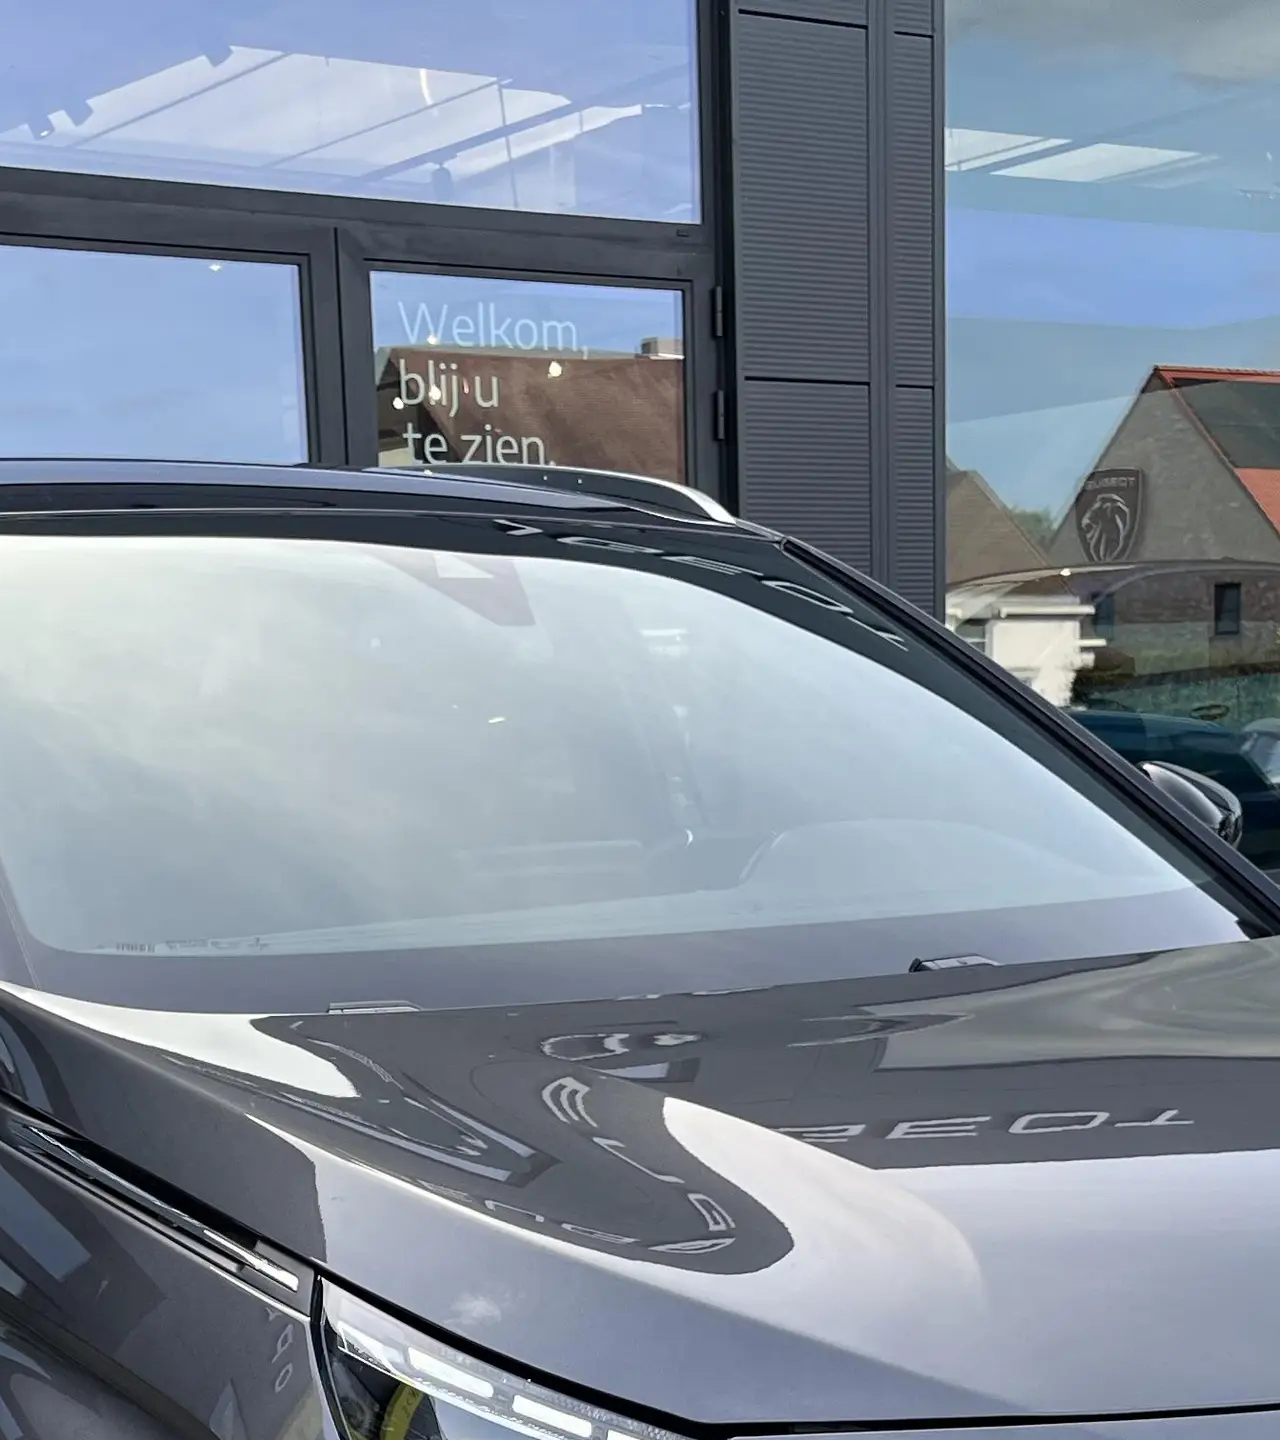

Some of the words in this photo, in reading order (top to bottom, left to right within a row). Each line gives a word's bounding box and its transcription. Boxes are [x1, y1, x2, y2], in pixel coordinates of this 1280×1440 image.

[398, 302, 589, 359] Welkom,
[400, 359, 461, 417] blij
[475, 375, 500, 408] u
[403, 422, 448, 465] te
[461, 424, 557, 467] zien.
